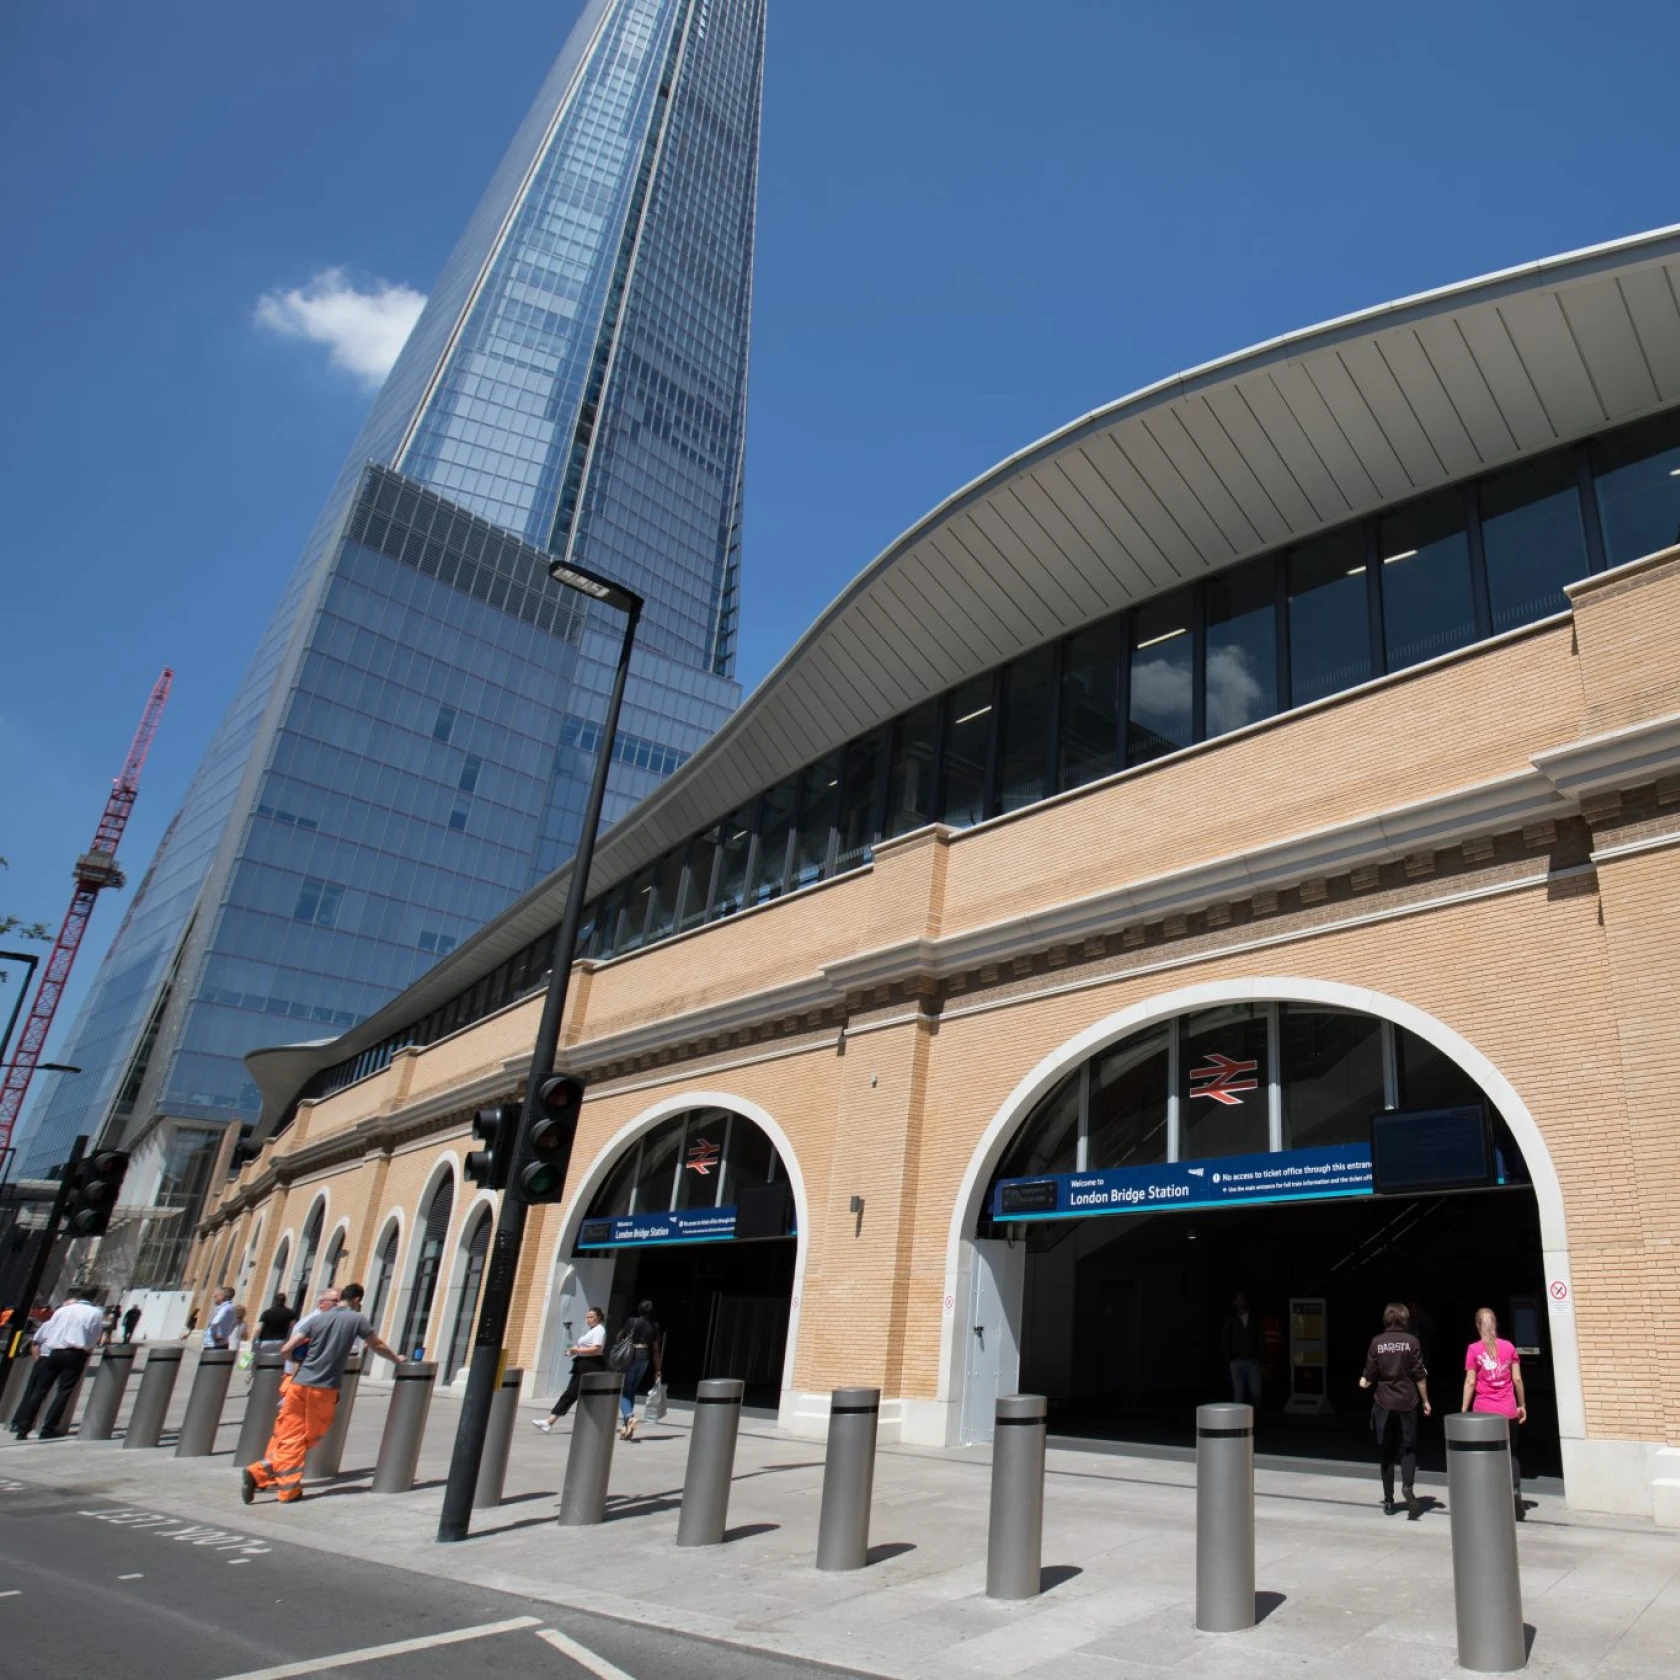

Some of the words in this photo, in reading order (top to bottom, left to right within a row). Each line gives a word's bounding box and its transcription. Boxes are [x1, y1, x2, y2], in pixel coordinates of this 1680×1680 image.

[1222, 1173, 1233, 1181] No
[1233, 1173, 1254, 1181] access
[1255, 1171, 1262, 1179] to
[1263, 1169, 1282, 1178] ticket
[1283, 1167, 1303, 1177] office
[1304, 1164, 1331, 1174] through
[1332, 1163, 1346, 1172] this
[1347, 1161, 1373, 1170] entran
[1071, 1180, 1097, 1188] Welcome
[1070, 1191, 1108, 1205] London
[1110, 1187, 1145, 1203] Bridge
[1148, 1184, 1190, 1199] Station
[615, 1229, 633, 1239] London
[634, 1228, 650, 1239] Bridge
[651, 1227, 669, 1237] Station
